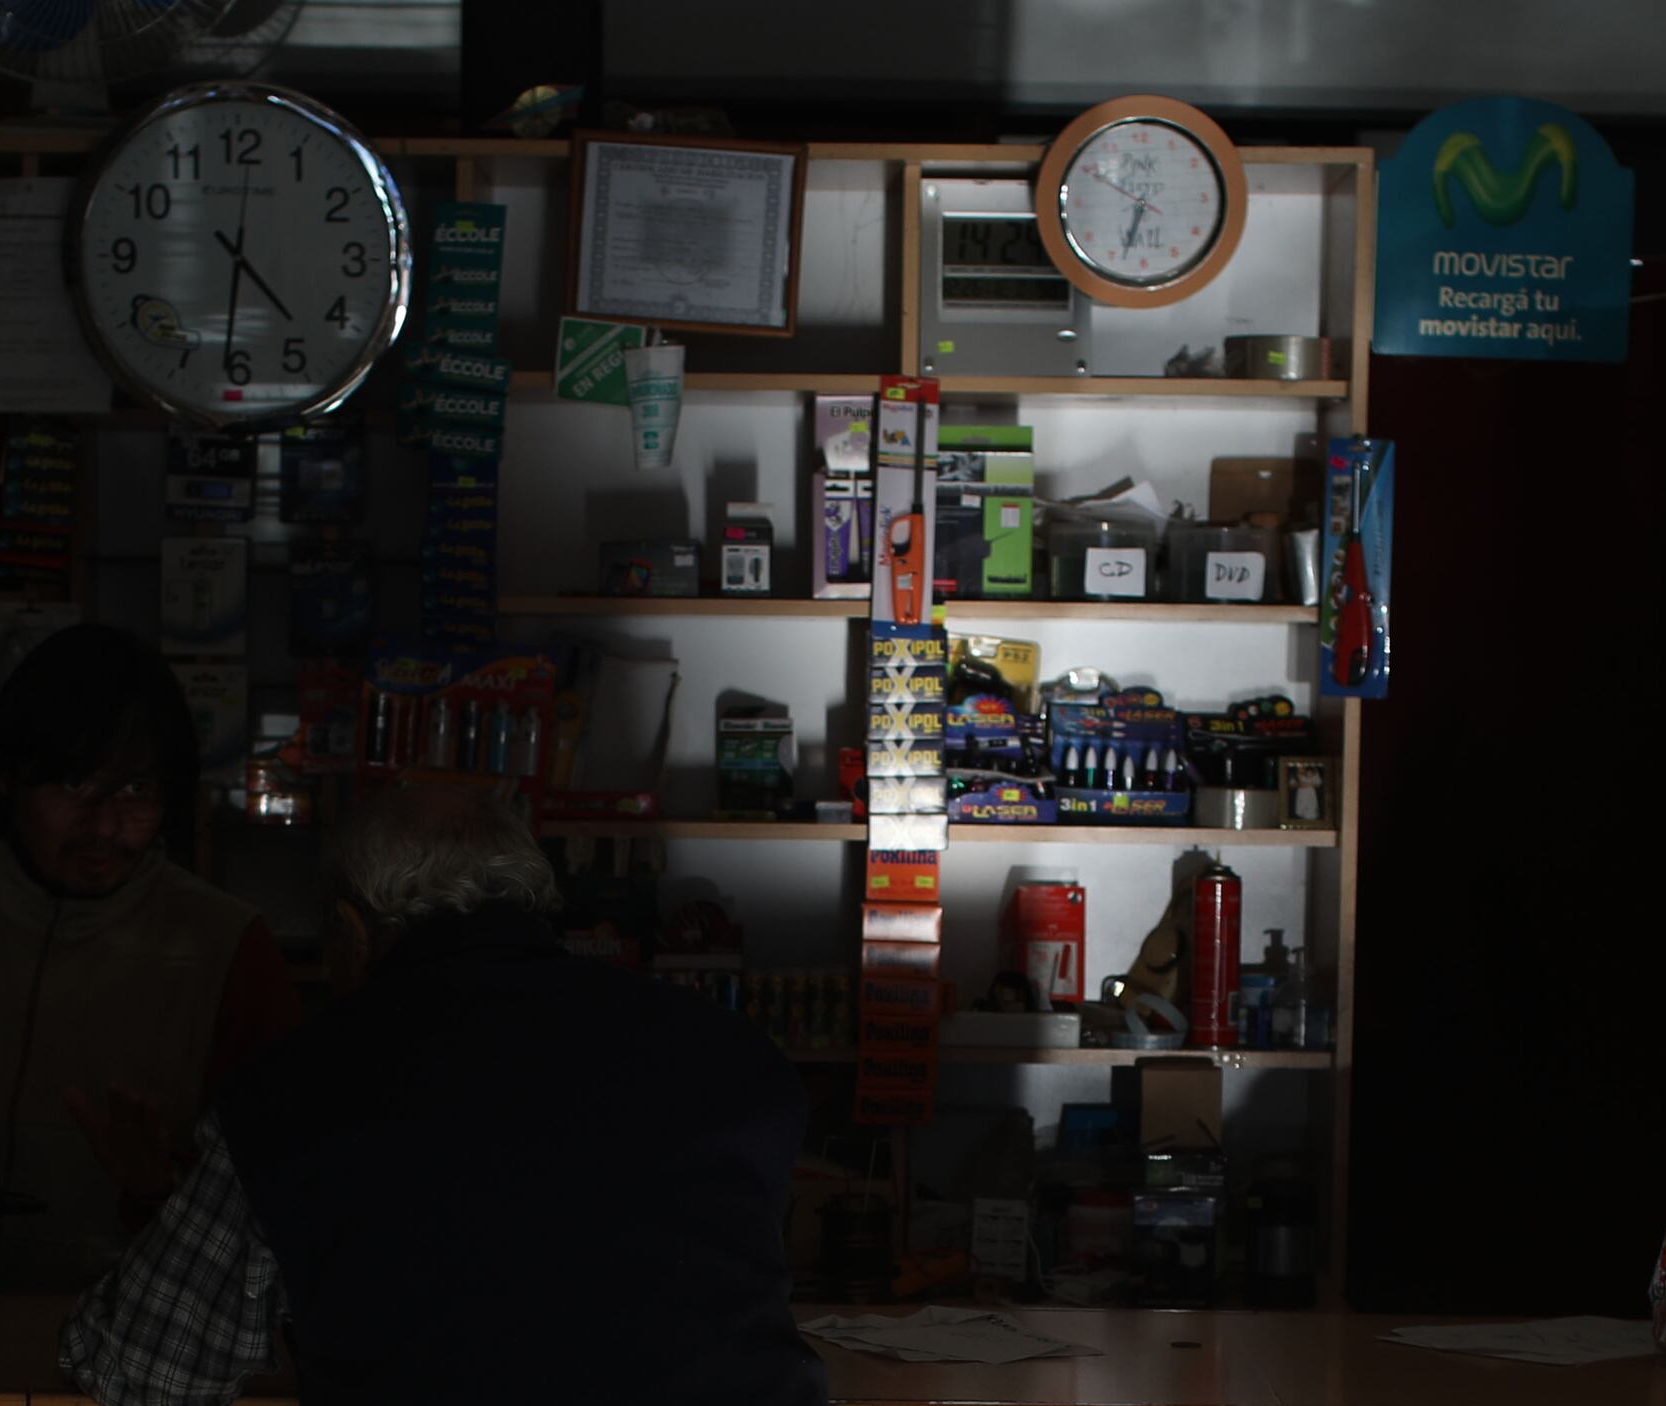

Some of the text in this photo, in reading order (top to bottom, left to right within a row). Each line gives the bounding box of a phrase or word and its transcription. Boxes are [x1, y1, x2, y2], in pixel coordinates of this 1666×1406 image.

[167, 144, 200, 179] 11
[219, 130, 262, 165] 12
[290, 147, 303, 181] 1
[129, 184, 170, 219] 10
[325, 188, 350, 223] 2
[111, 238, 136, 273] 9
[342, 242, 366, 277] 3
[325, 296, 349, 329] 4
[1438, 286, 1560, 317] Recargá tu
[1418, 314, 1582, 347] movistar aquí.
[227, 350, 252, 385] 6
[282, 338, 306, 373] 5
[439, 354, 506, 381] ÉCCOLE
[571, 374, 595, 398] EN
[434, 393, 499, 416] ÉCCOLE
[431, 430, 495, 453] ÉCCOLE
[186, 449, 217, 468] 64
[1098, 560, 1133, 577] CD
[1215, 563, 1250, 582] DVD
[872, 638, 945, 661] POXIPOL
[871, 671, 944, 697] POXIPOL
[870, 707, 943, 733] POXIPOL
[870, 745, 942, 771] POXIPOL
